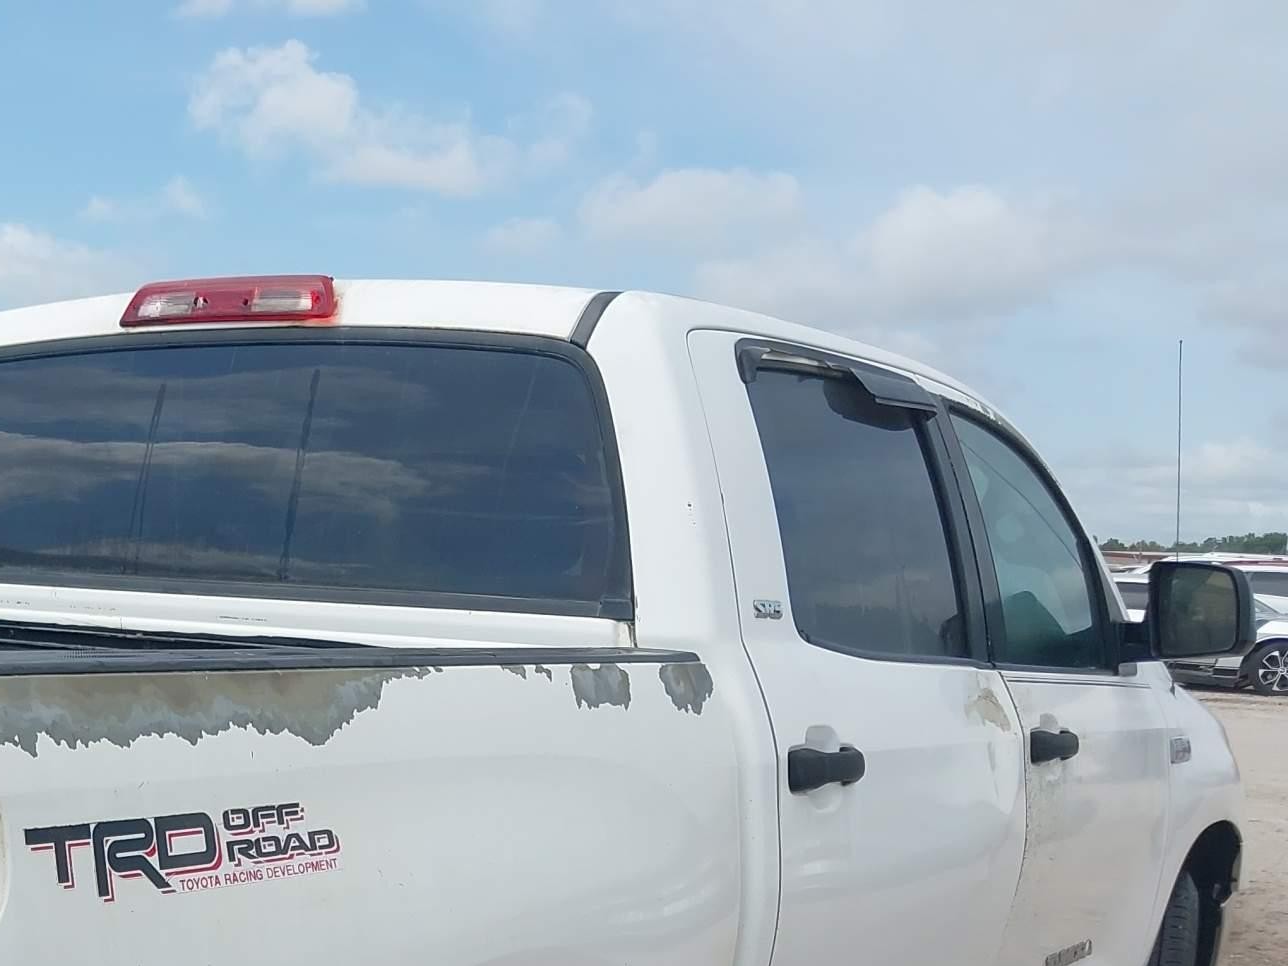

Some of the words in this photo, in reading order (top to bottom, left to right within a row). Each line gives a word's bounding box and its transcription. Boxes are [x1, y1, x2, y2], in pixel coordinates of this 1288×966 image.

[223, 802, 305, 837] OFF
[24, 812, 223, 902] TRD
[226, 828, 340, 867] ROAD
[179, 876, 222, 893] TOYOTA
[224, 869, 264, 885] RACING
[265, 857, 339, 881] DEVELOPMENT
